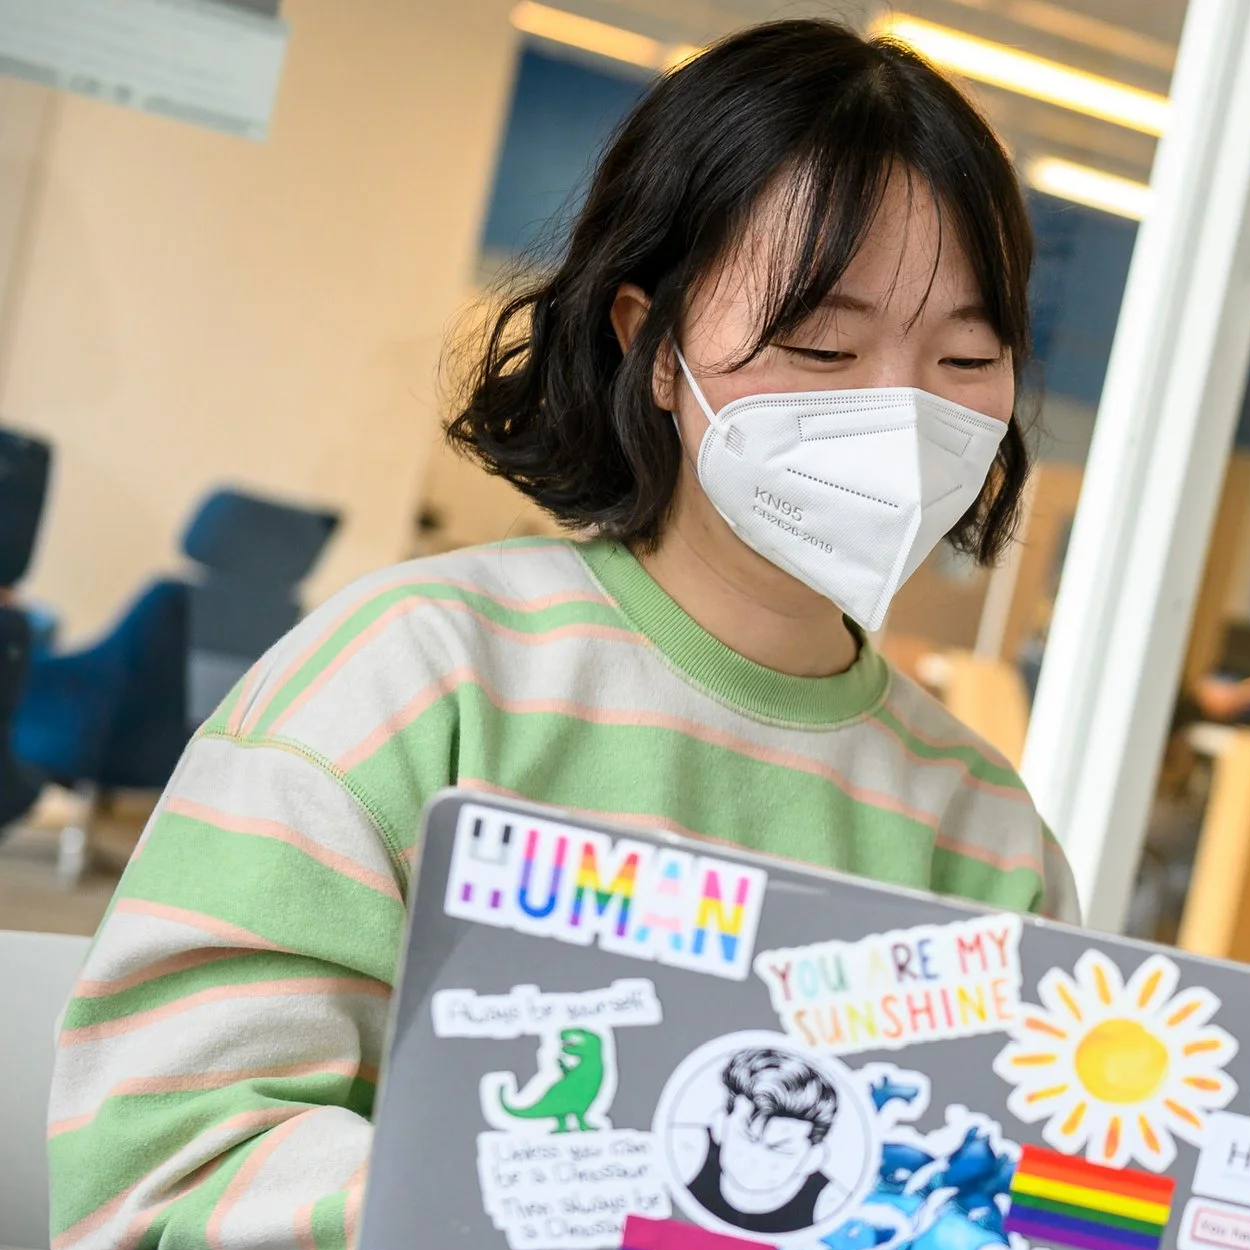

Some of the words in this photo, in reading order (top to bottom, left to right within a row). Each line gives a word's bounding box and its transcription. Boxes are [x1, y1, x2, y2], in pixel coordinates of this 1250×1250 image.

[752, 505, 833, 554] GB2626-2019
[754, 486, 803, 523] KN95
[461, 818, 750, 962] HUMAN
[770, 954, 848, 1001] YOU
[867, 938, 939, 988] ARE
[956, 926, 1010, 975] MY
[793, 977, 1015, 1047] SUNSHINE
